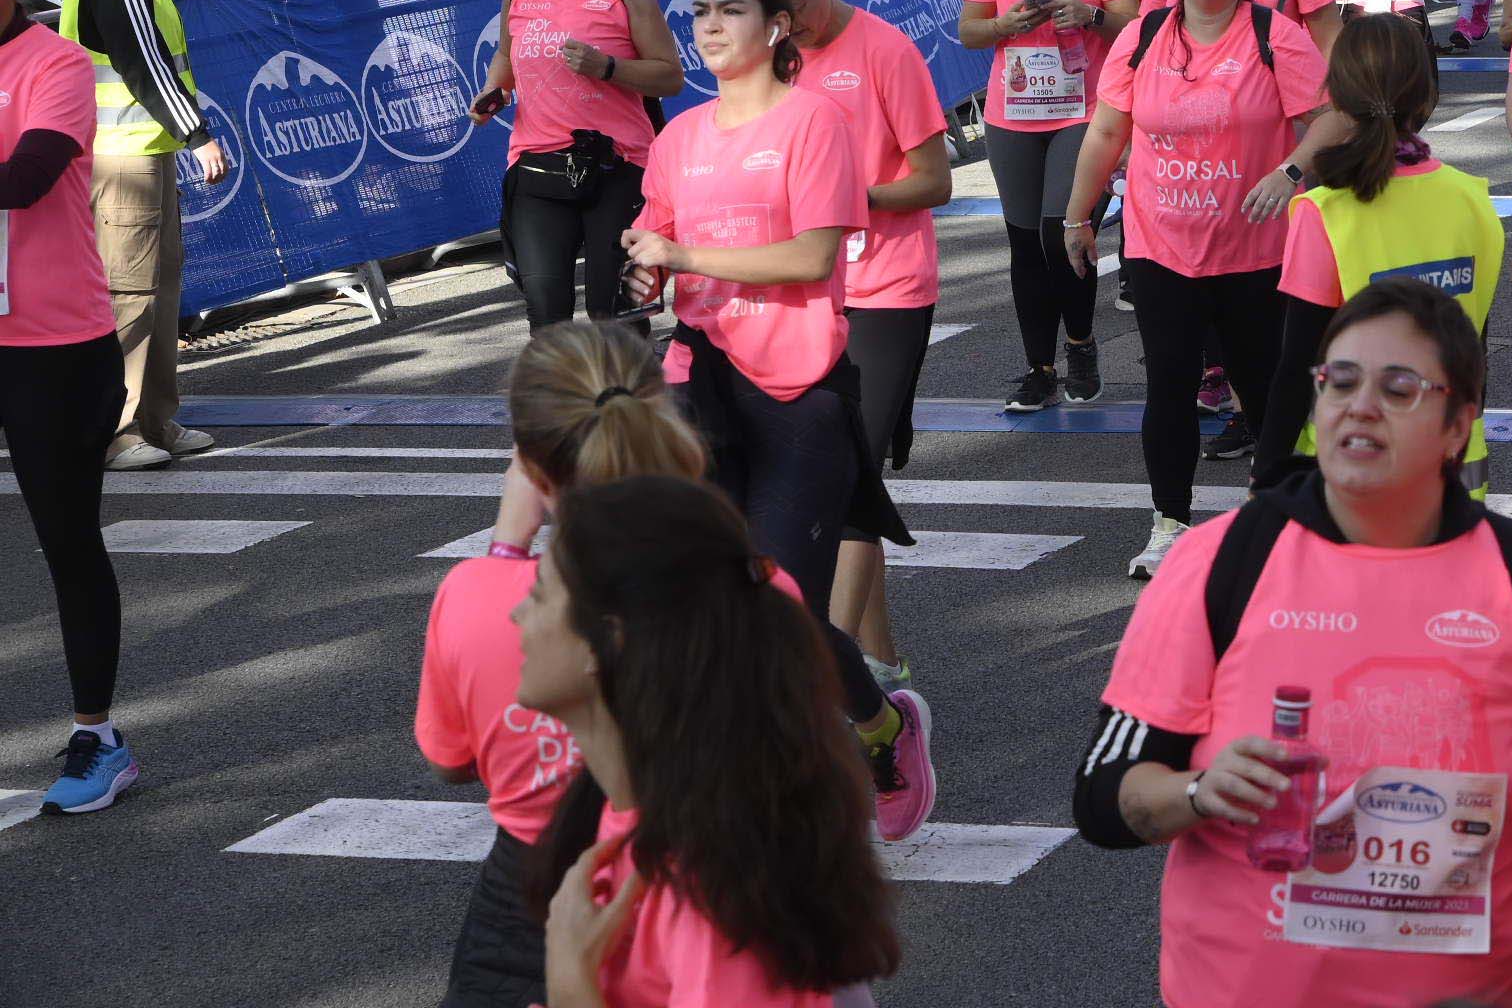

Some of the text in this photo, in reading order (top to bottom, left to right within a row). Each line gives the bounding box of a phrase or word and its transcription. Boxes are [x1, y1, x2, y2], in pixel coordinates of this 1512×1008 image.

[519, 2, 551, 11] OYSHO
[526, 19, 552, 31] HOY
[521, 32, 570, 45] GANAN
[518, 45, 540, 58] LAS
[1029, 75, 1056, 86] 016
[257, 107, 361, 159] ASTURIANA
[1150, 134, 1174, 151] TU
[1157, 159, 1242, 179] DORSAL
[1157, 186, 1219, 209] SUMA
[1269, 609, 1358, 633] OYSHO
[1431, 622, 1494, 642] ASTURIANA
[1364, 795, 1438, 816] ASTURIANA
[1364, 837, 1430, 865] 016
[1368, 871, 1420, 890] 12750
[1312, 890, 1367, 905] CARRERA
[1370, 897, 1387, 907] DE
[1389, 898, 1402, 907] LA
[1303, 914, 1474, 937] OYSHO Santander
